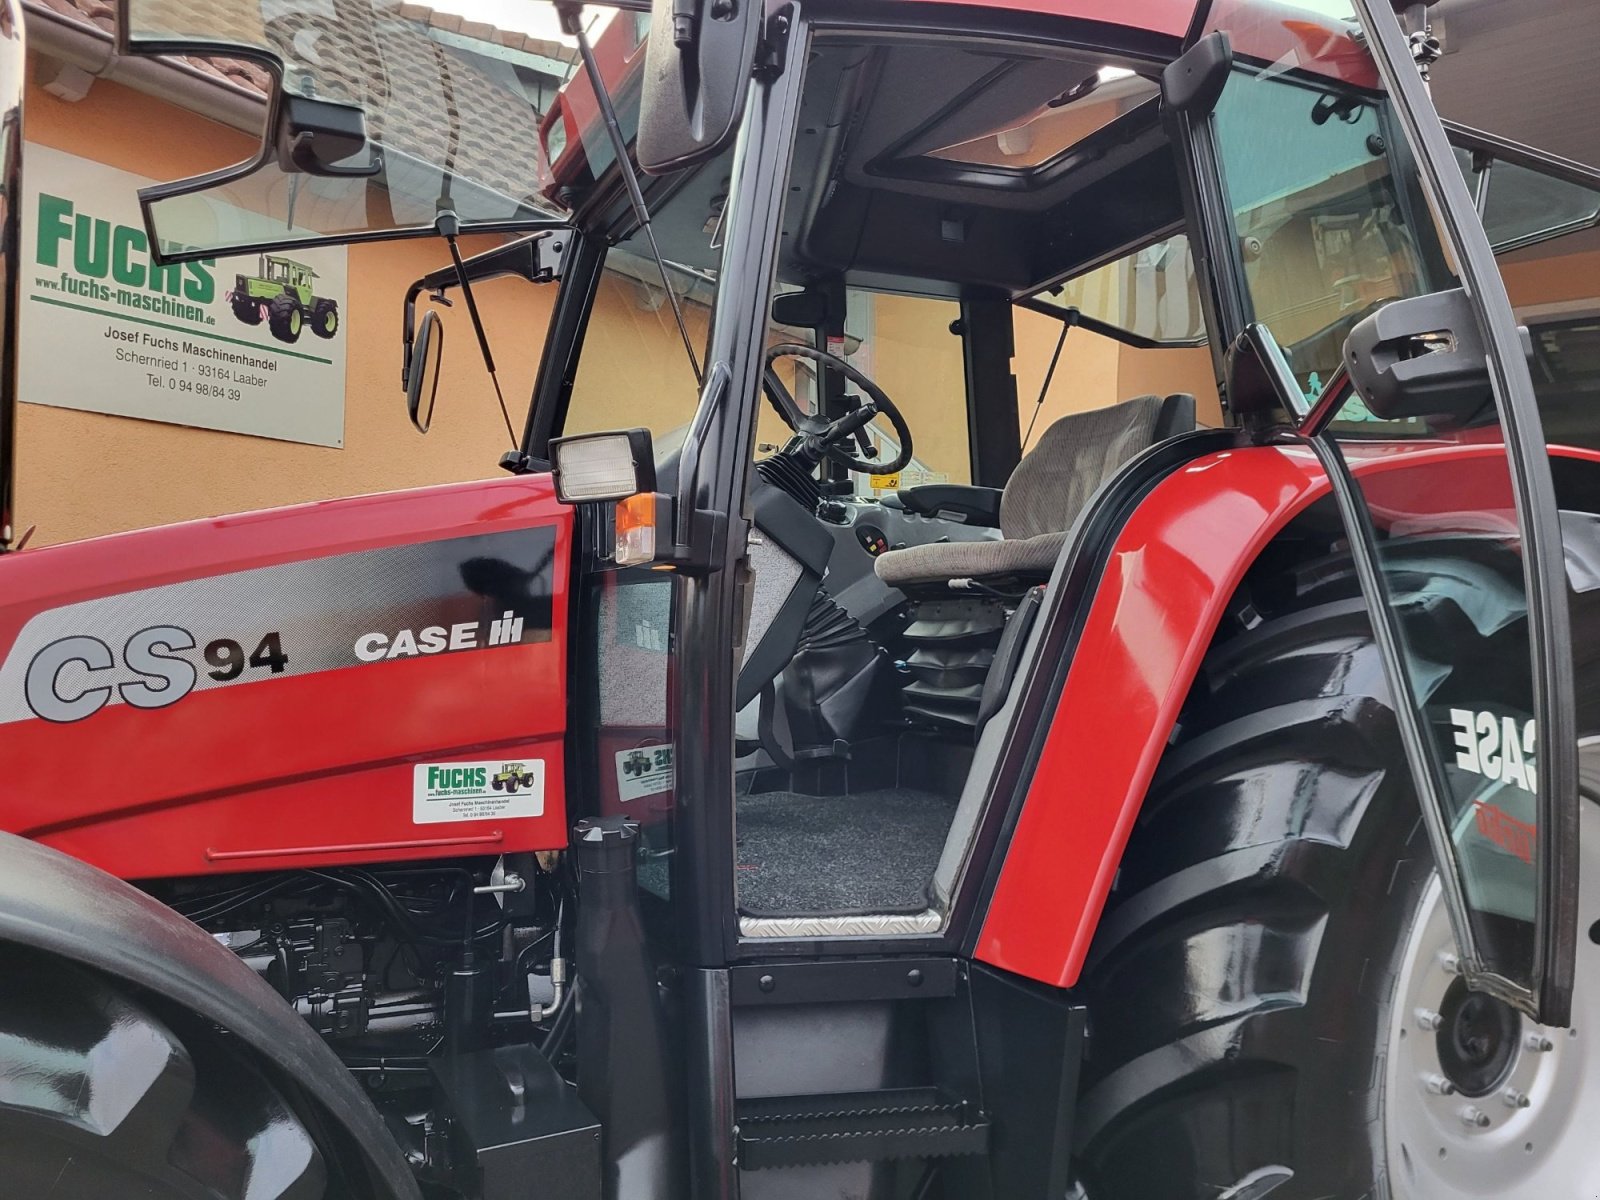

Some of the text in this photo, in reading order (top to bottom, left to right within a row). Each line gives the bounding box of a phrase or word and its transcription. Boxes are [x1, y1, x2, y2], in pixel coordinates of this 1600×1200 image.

[35, 272, 215, 326] www.fuchs-maschinen.de
[104, 326, 277, 371] Josef Fuchs Maschinenhandel
[115, 348, 178, 371] Schernried
[182, 362, 187, 372] 1
[198, 364, 230, 380] 93164
[233, 371, 267, 388] Laaber
[146, 373, 241, 401] Tel. 0 94 98/84 39
[354, 621, 480, 662] CASE
[24, 625, 288, 723] CS 94
[427, 766, 486, 789] FUCHS
